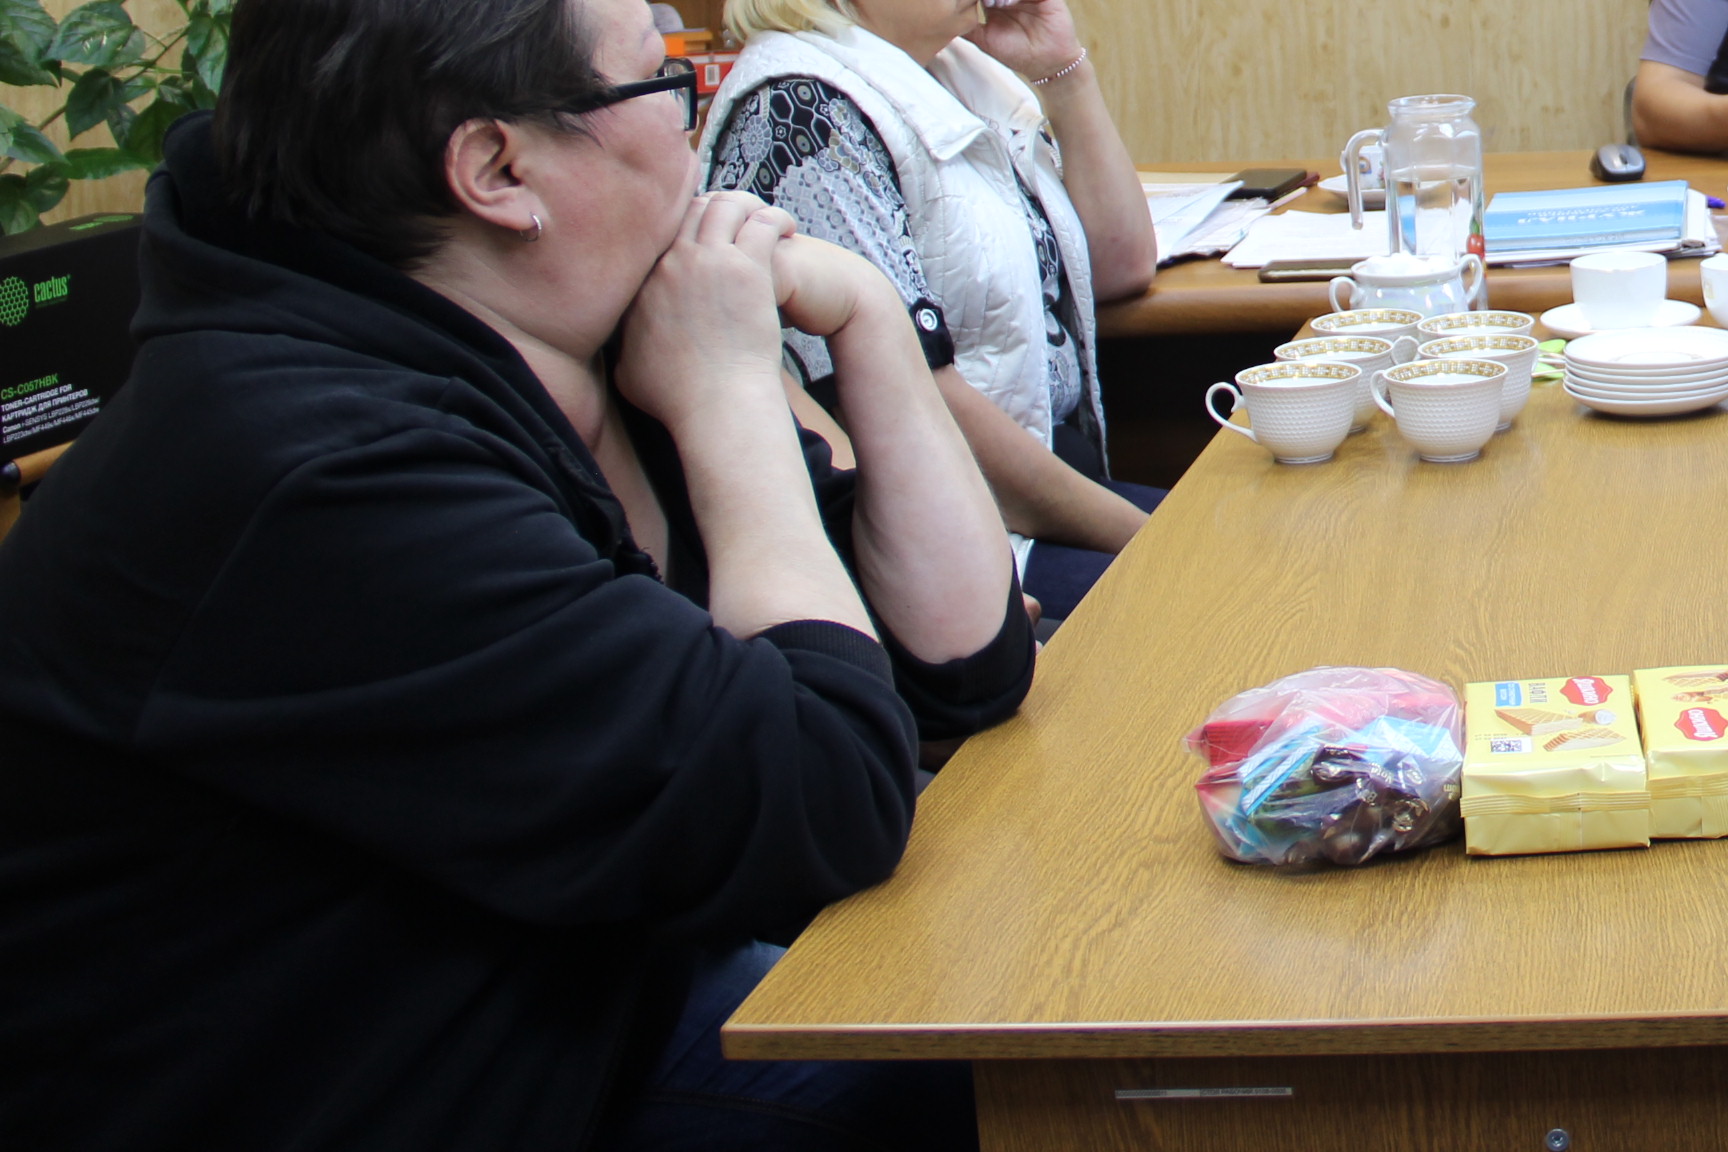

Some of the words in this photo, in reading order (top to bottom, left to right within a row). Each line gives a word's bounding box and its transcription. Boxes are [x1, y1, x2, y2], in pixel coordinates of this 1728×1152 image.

[34, 276, 68, 303] cactus
[0, 373, 59, 400] CS-C057HBK
[1, 388, 59, 412] TONER-CARTRIDGE
[60, 383, 73, 394] FOR
[1, 405, 37, 423] КАРТРИДЖ
[38, 400, 52, 412] ДЛЯ
[52, 388, 89, 406] ПРИНТЕРОВ
[2, 423, 21, 434] Canon
[1687, 708, 1719, 738] Яшкино
